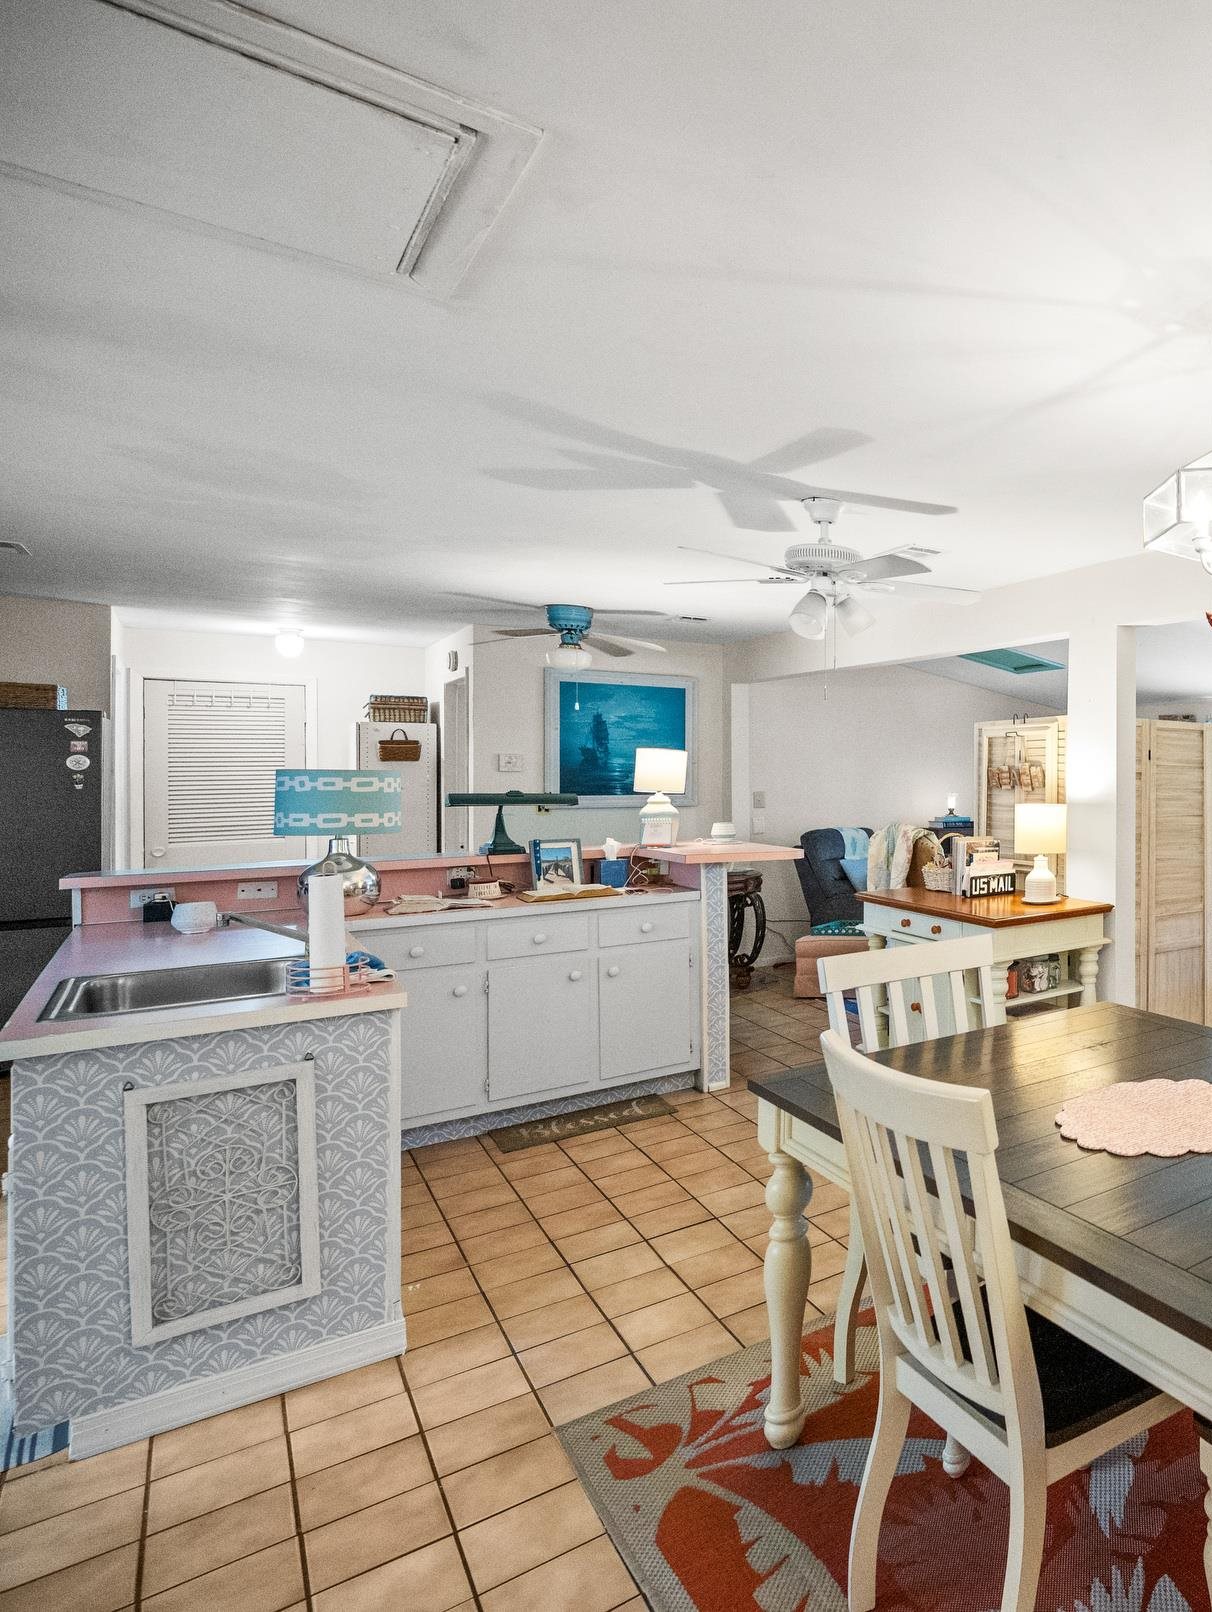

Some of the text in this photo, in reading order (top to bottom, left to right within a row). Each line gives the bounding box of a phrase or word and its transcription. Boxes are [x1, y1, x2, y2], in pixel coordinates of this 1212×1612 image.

[972, 875, 1014, 895] US MAIL
[519, 1098, 648, 1138] Blessed
